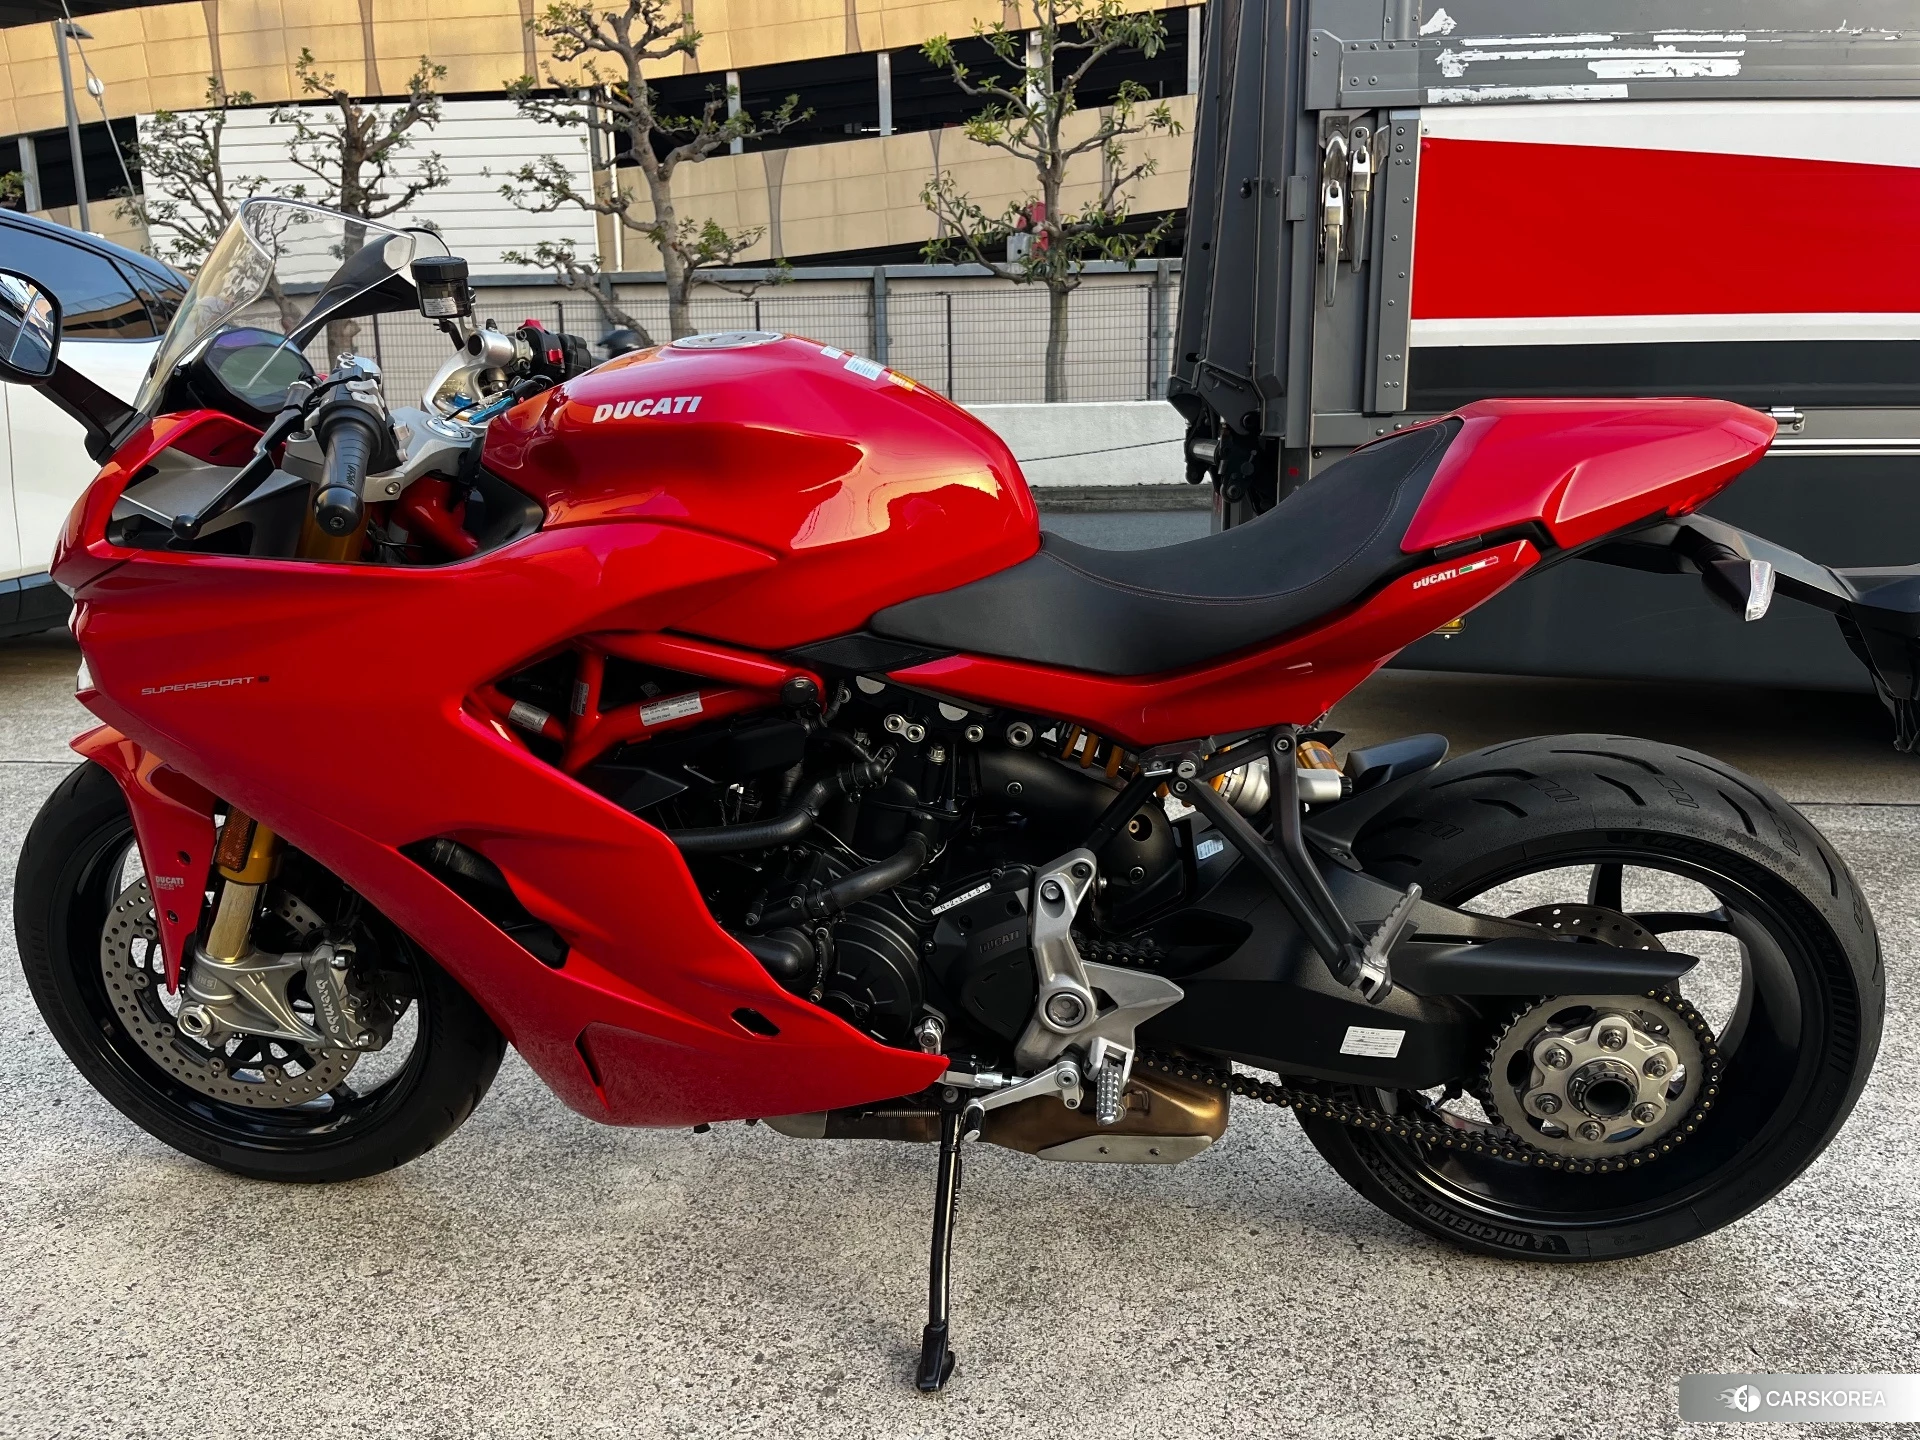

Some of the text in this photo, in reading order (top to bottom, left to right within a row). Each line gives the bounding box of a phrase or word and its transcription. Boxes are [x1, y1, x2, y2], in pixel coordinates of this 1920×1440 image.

[592, 396, 702, 424] DUCATI
[1412, 568, 1456, 589] DUCATI
[141, 676, 255, 696] SUPERSPORT
[1724, 828, 1783, 863] POWER
[155, 875, 184, 885] DUCATI
[979, 930, 1020, 954] DUCATI
[316, 979, 340, 1034] brembo
[1377, 1163, 1416, 1200] POWER
[1423, 1203, 1528, 1248] MICHELIN
